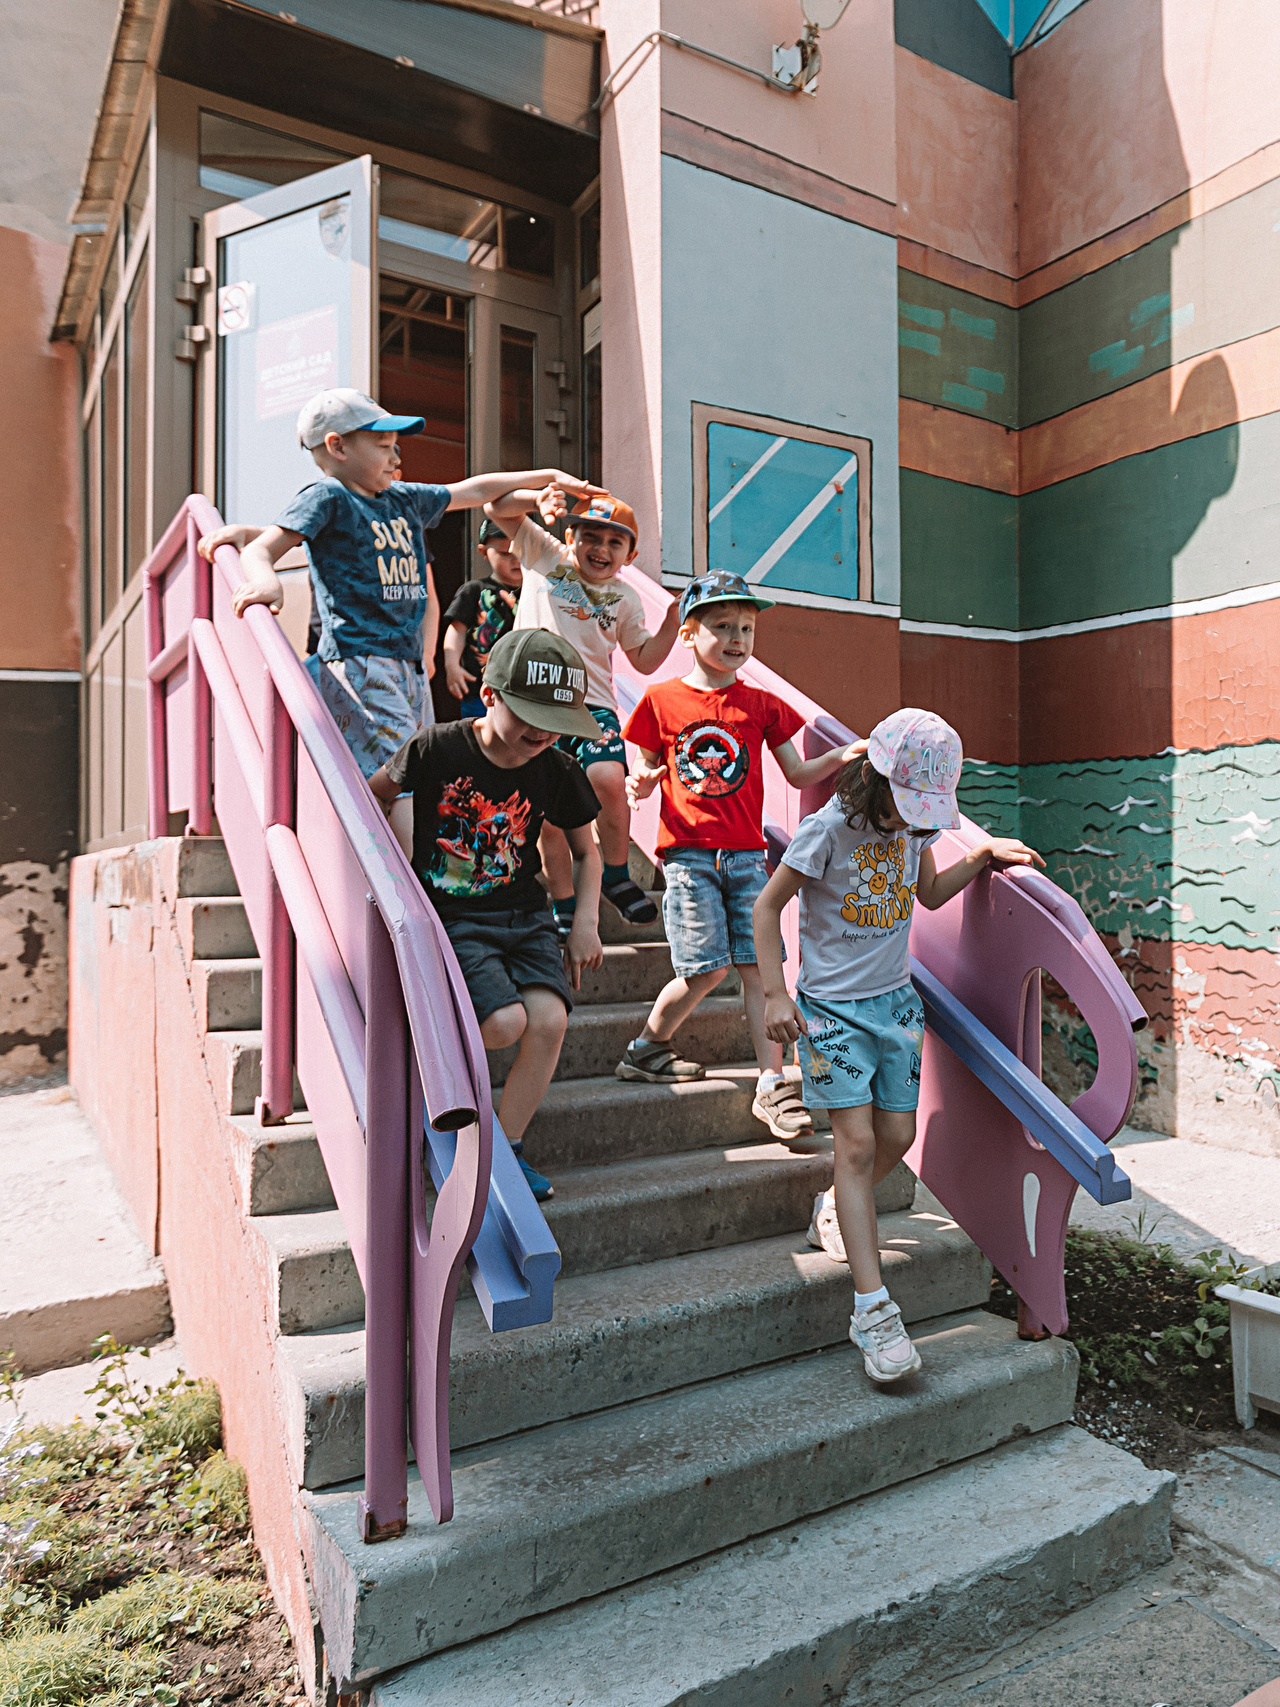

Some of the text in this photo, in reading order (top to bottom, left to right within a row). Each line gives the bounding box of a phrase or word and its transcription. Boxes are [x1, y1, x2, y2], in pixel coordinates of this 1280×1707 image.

[526, 660, 585, 694] NEW YORK
[831, 1055, 863, 1079] HEART
